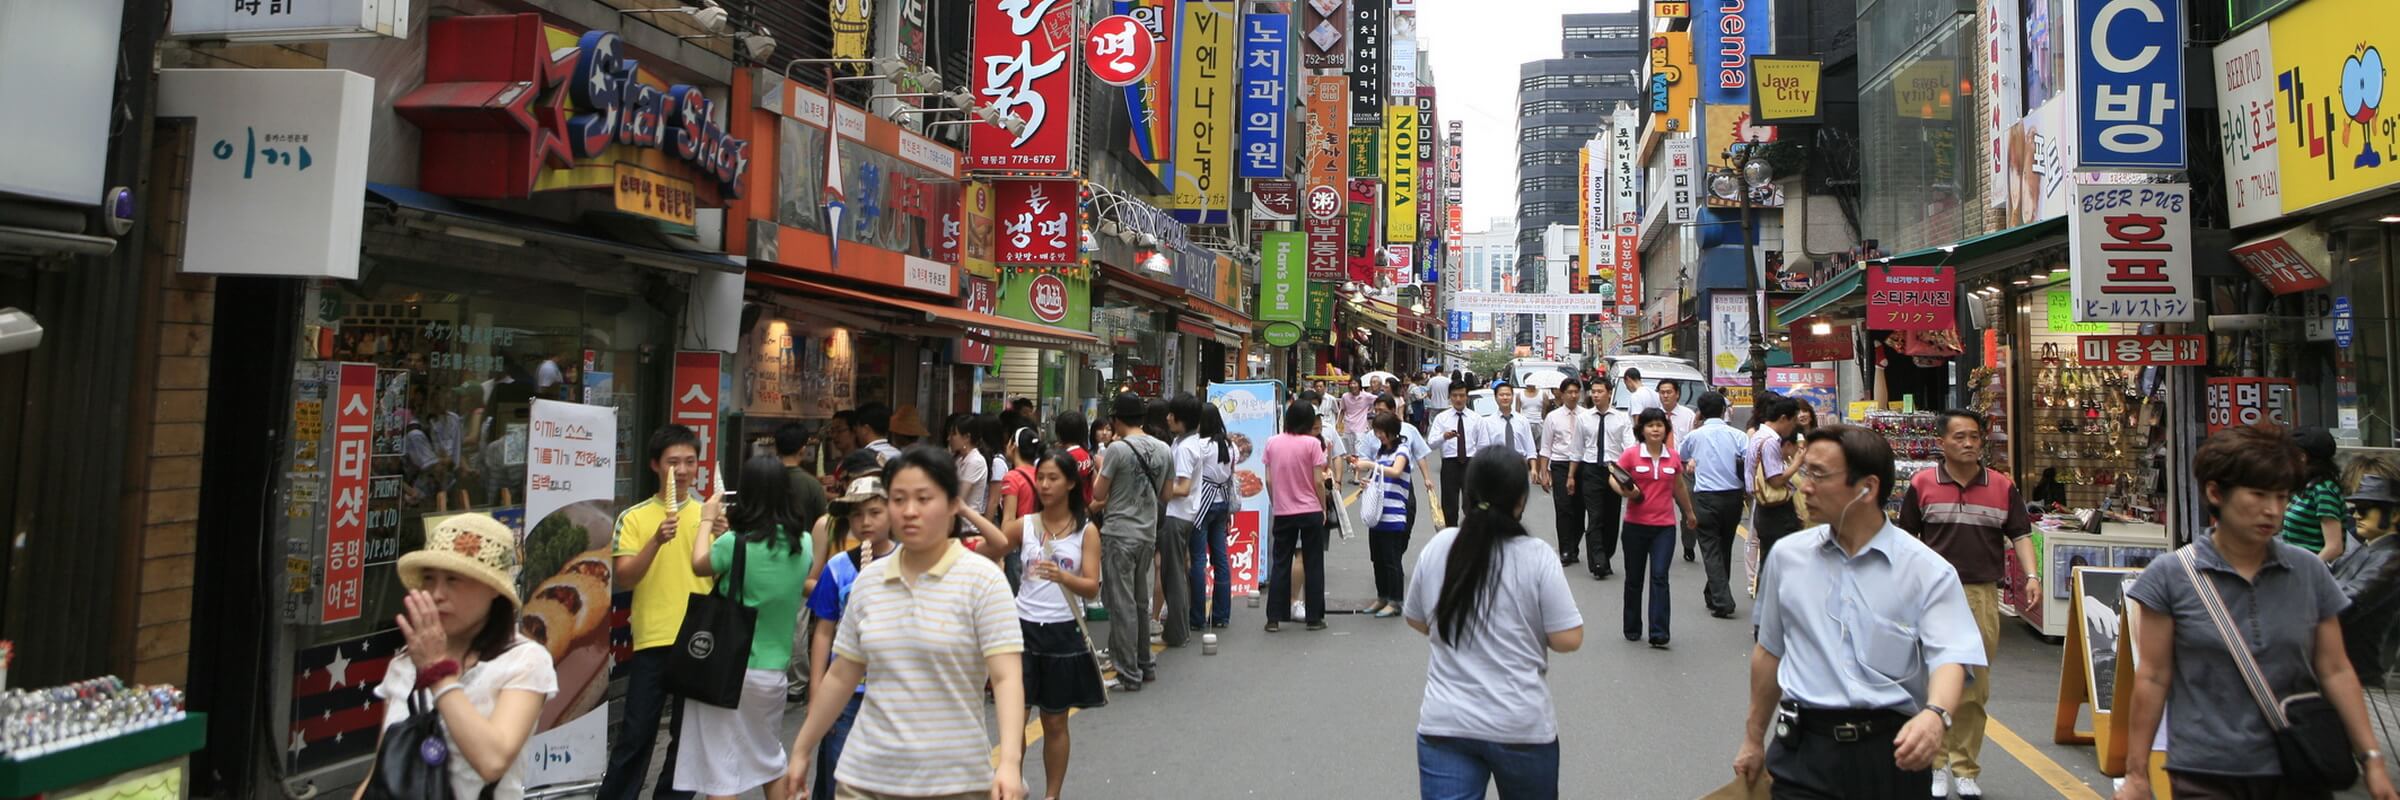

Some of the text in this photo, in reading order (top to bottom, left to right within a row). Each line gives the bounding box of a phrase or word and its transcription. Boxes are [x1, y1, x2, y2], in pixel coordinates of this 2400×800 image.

[1662, 4, 1680, 15] 6F
[1305, 54, 1344, 65] 752-1919
[1360, 9, 1377, 106] 이철헤어커커
[2225, 48, 2262, 92] BEER PUB
[1193, 12, 1219, 192] 비엔나안경
[1247, 20, 1283, 169] 노치과의원
[1653, 73, 1666, 112] PAPA
[1762, 73, 1799, 88] Java
[1776, 86, 1810, 104] City
[570, 30, 748, 199] Star Shot
[1420, 98, 1431, 158] DVD방
[2278, 66, 2335, 181] 가나
[1012, 155, 1056, 164] 778-6767
[1395, 113, 1411, 207] NOLITA
[1592, 176, 1603, 233] kolon plaz
[2082, 188, 2184, 214] BEER PUB
[1004, 212, 1067, 248] 냉면
[1310, 227, 1339, 270] 부동산
[2100, 213, 2176, 294] 호프
[1275, 242, 1290, 310] Han's Deli
[1872, 290, 1951, 307] 스티커사진
[1887, 311, 1935, 322] プリクラ
[2084, 338, 2200, 362] 미용실 3F
[335, 393, 372, 528] 스타샷
[327, 578, 358, 611] 여권
